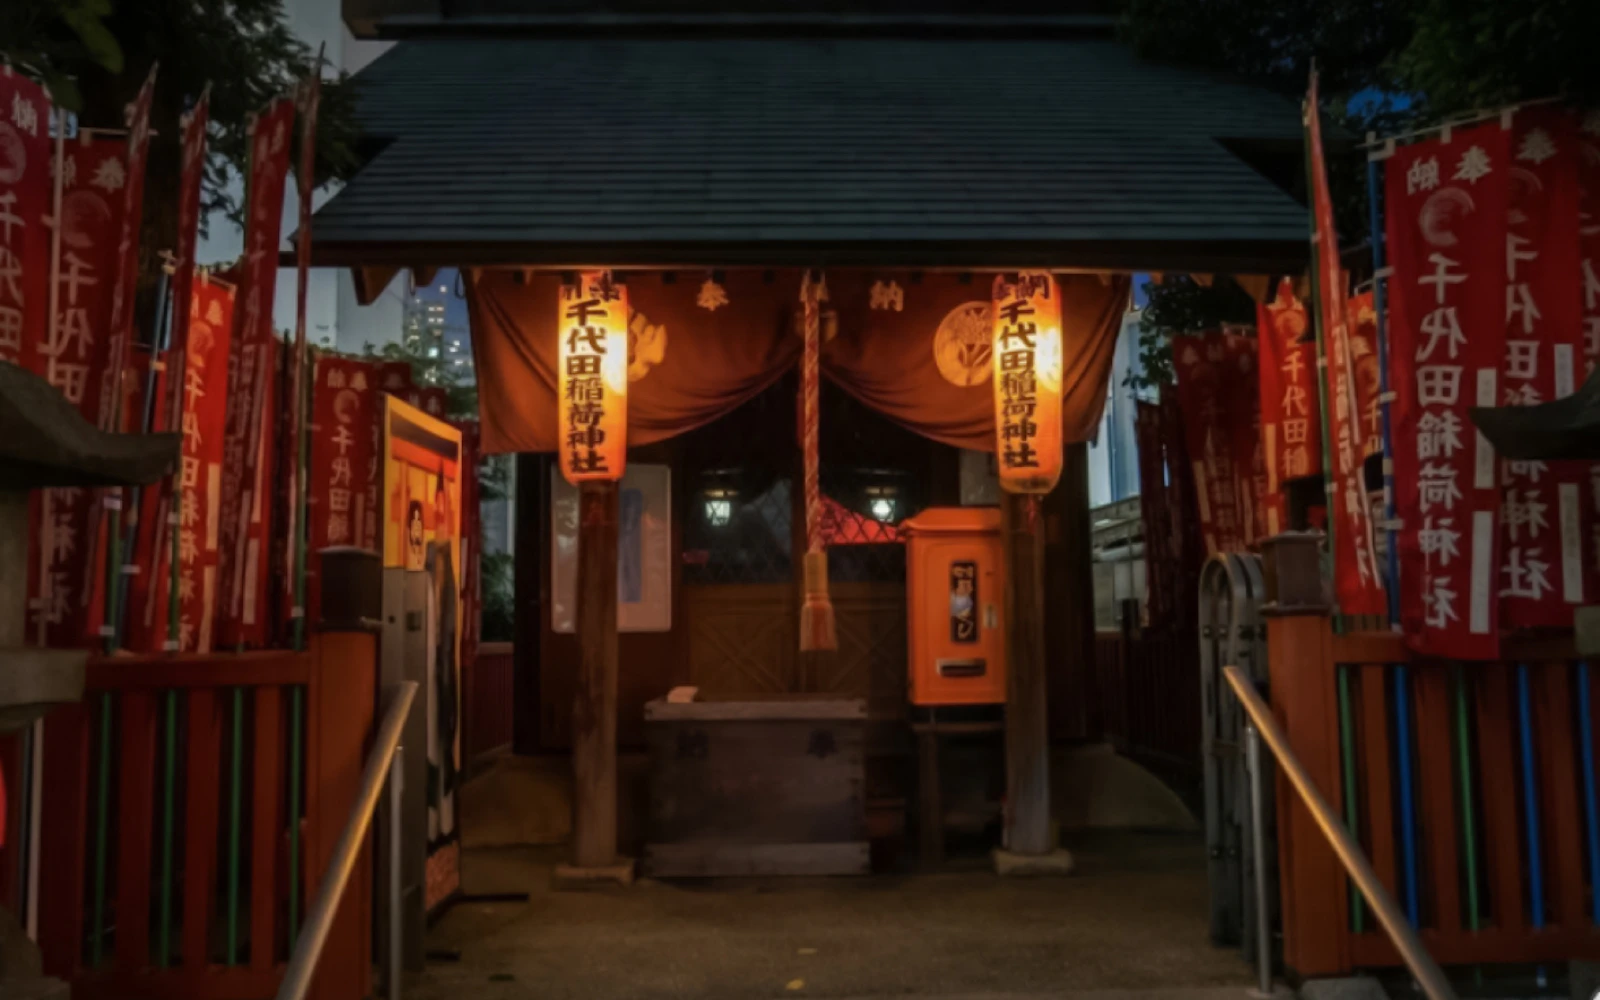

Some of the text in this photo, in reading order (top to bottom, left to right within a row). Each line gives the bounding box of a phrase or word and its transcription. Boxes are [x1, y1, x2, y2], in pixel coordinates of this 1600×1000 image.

[565, 299, 609, 474] 千代田稲荷神社
[999, 299, 1040, 468] 千代田稲荷神社
